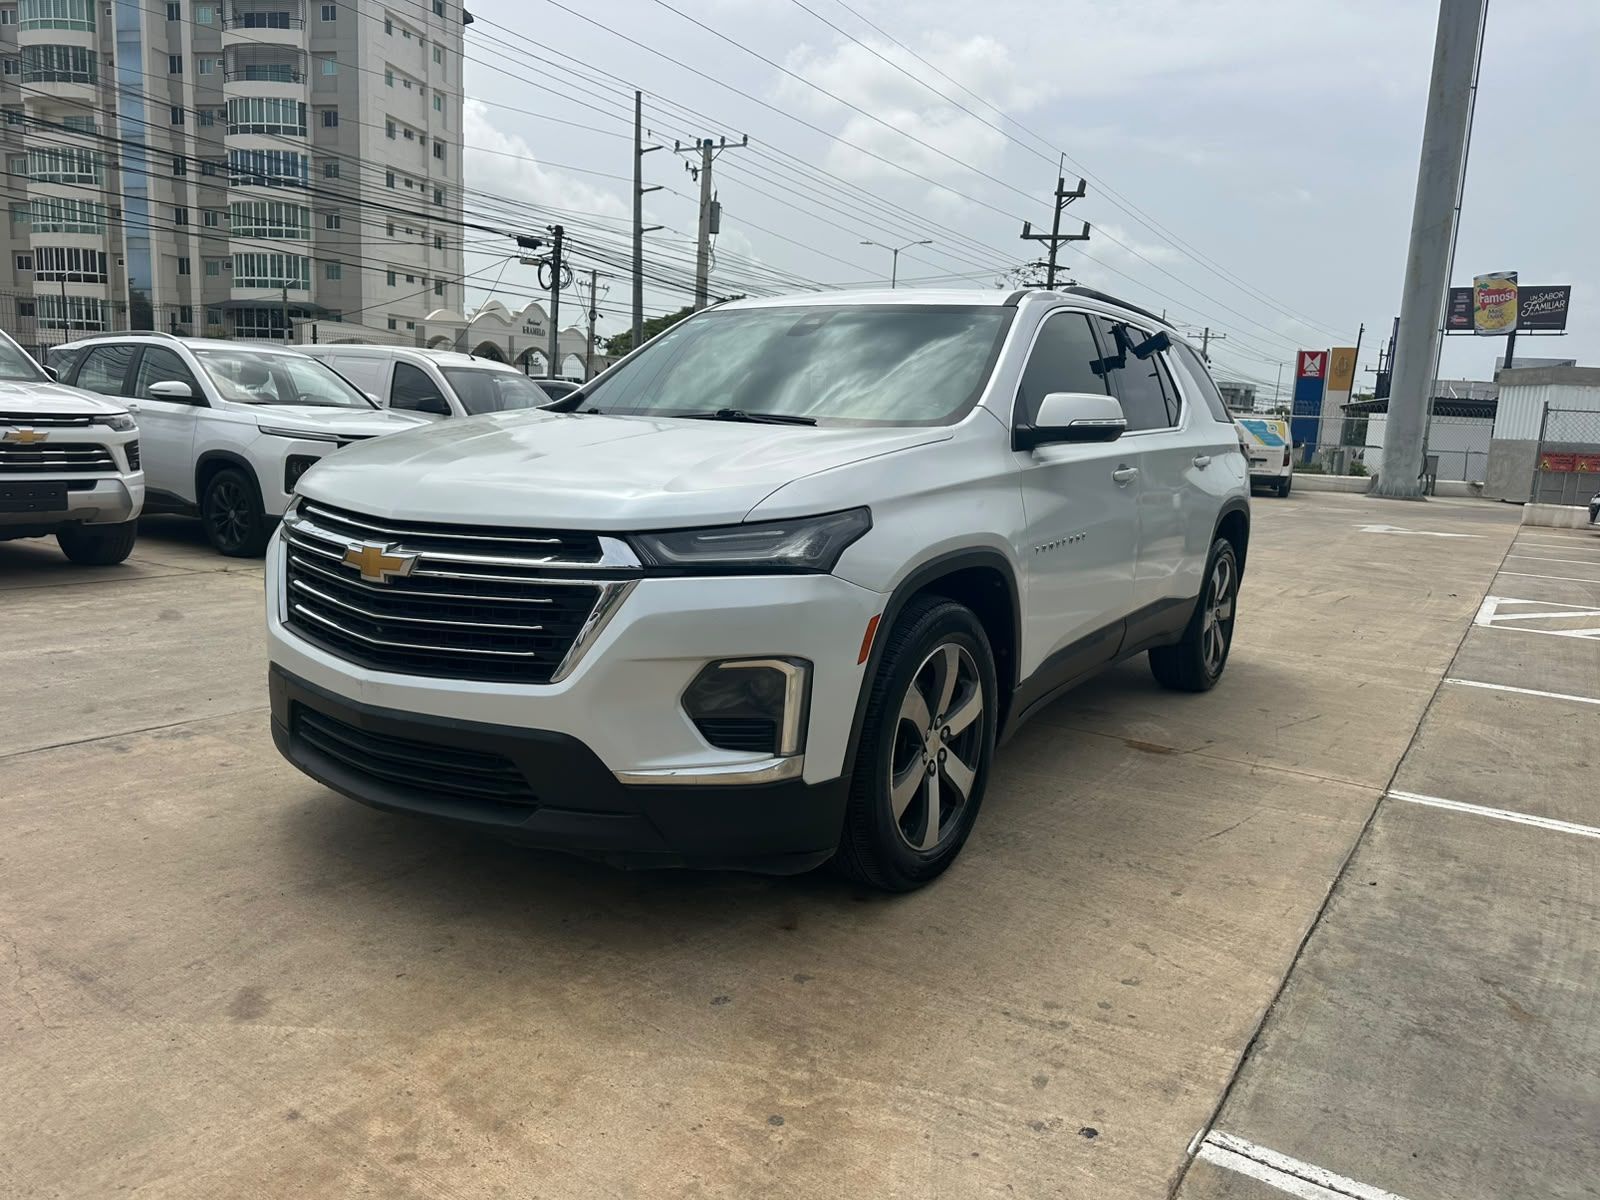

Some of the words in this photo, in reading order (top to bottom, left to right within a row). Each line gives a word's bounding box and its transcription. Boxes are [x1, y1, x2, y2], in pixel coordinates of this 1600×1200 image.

[1479, 291, 1515, 304] Famosa
[1537, 291, 1565, 303] SABOR
[1520, 300, 1566, 317] FAMILIAR
